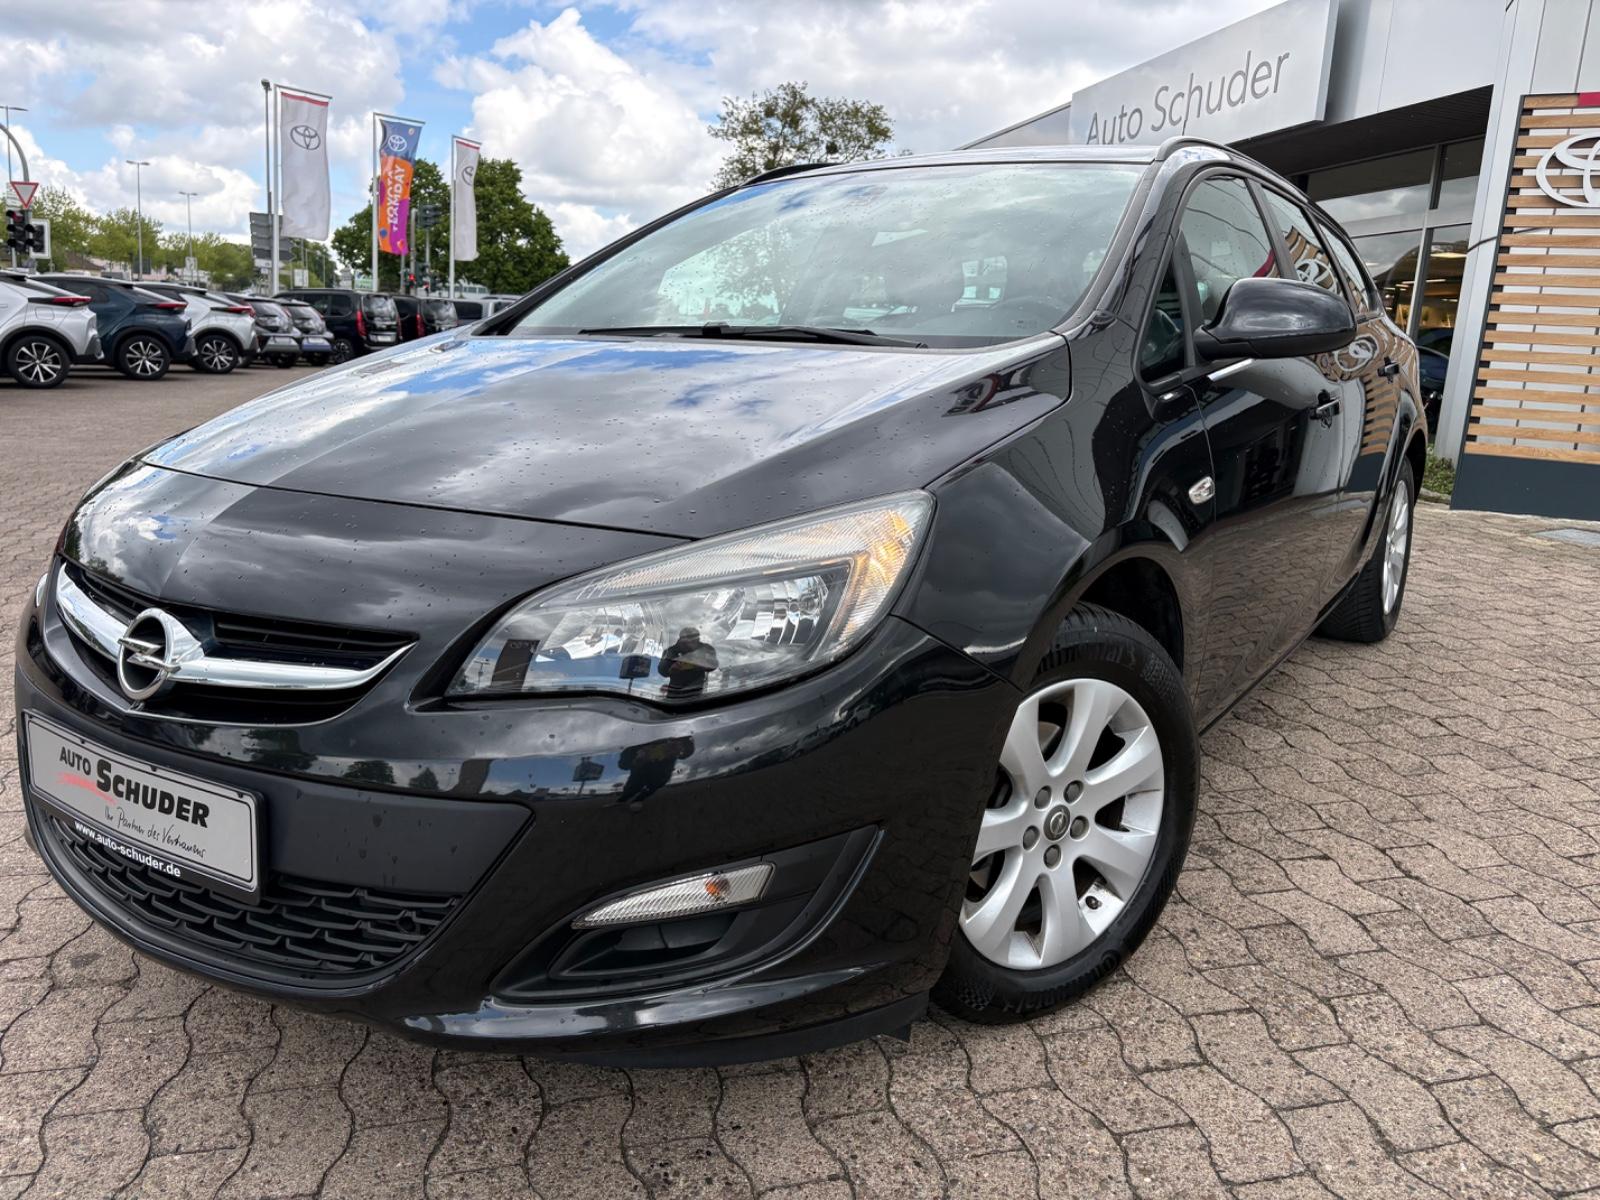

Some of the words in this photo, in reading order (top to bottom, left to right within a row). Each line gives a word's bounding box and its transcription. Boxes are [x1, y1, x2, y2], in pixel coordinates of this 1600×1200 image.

[1087, 104, 1143, 145] Auto
[1150, 50, 1290, 137] Schuder
[59, 746, 91, 776] AUTO
[96, 758, 209, 828] SCHUDER
[74, 821, 181, 878] www.auto-schuder.de
[147, 824, 160, 841] des
